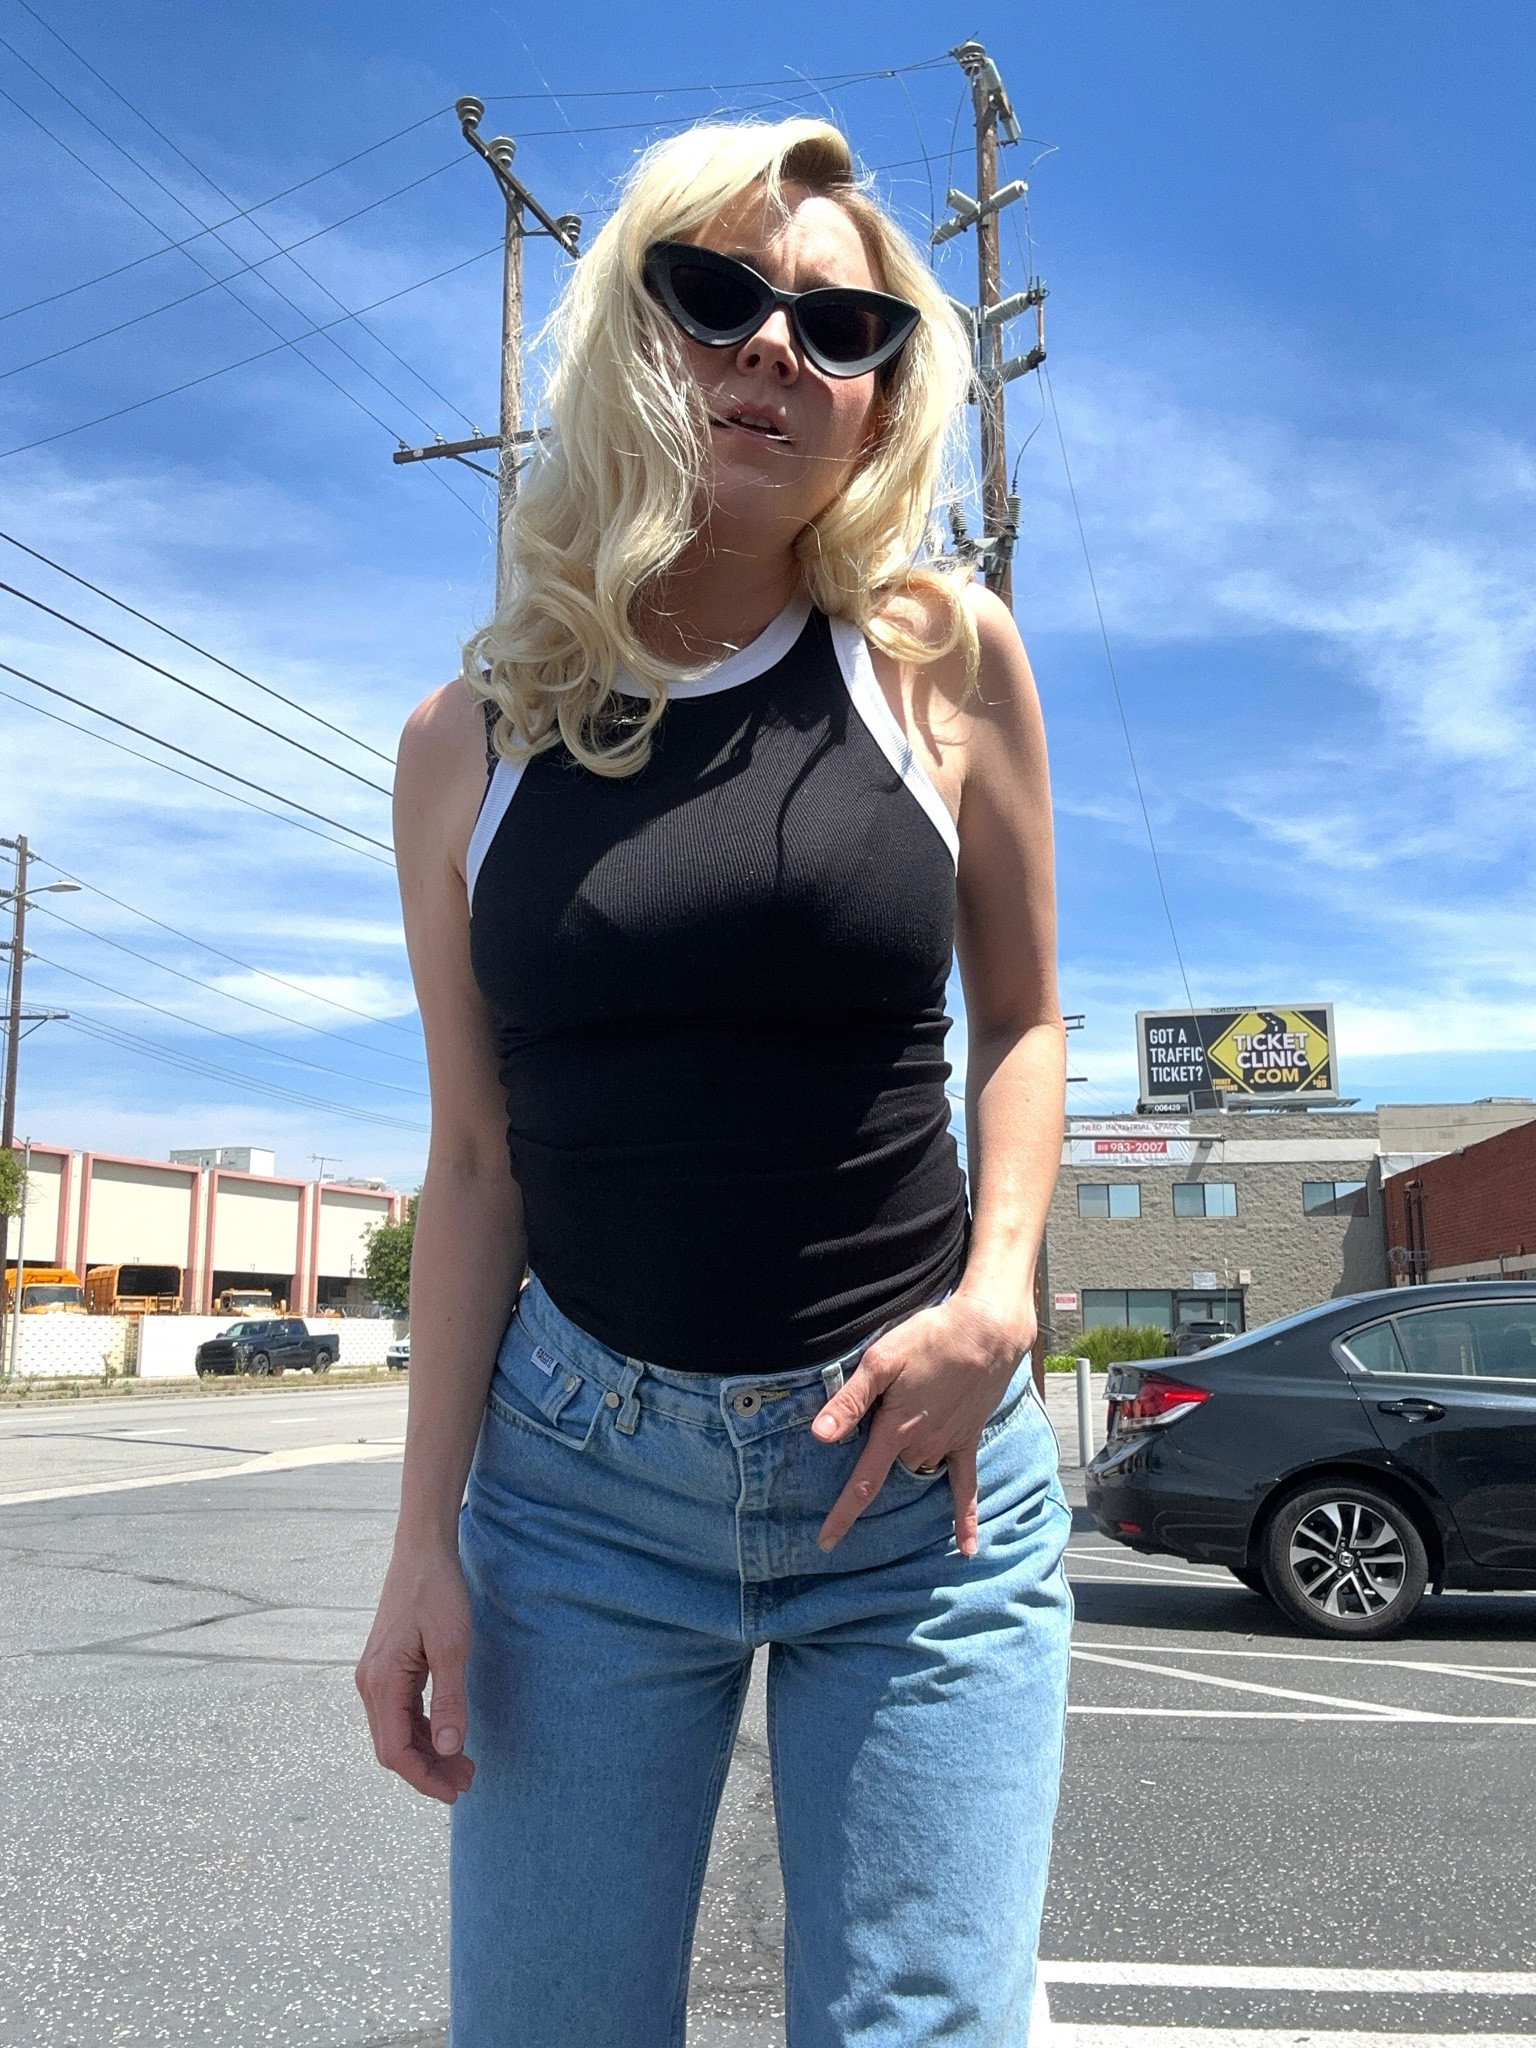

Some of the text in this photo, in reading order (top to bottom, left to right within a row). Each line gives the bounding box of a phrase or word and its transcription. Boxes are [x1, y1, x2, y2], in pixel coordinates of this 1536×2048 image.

[1150, 1028, 1187, 1044] GOT A
[1233, 1032, 1308, 1051] TICKET
[1150, 1046, 1203, 1063] TRAFFIC
[1236, 1050, 1308, 1068] CLINIC
[1150, 1065, 1203, 1083] TICKET?
[1249, 1067, 1300, 1083] .COM
[1081, 1123, 1103, 1131] NEED
[1105, 1122, 1151, 1131] INDUSTRIAL
[1110, 1141, 1165, 1153] 983-2007
